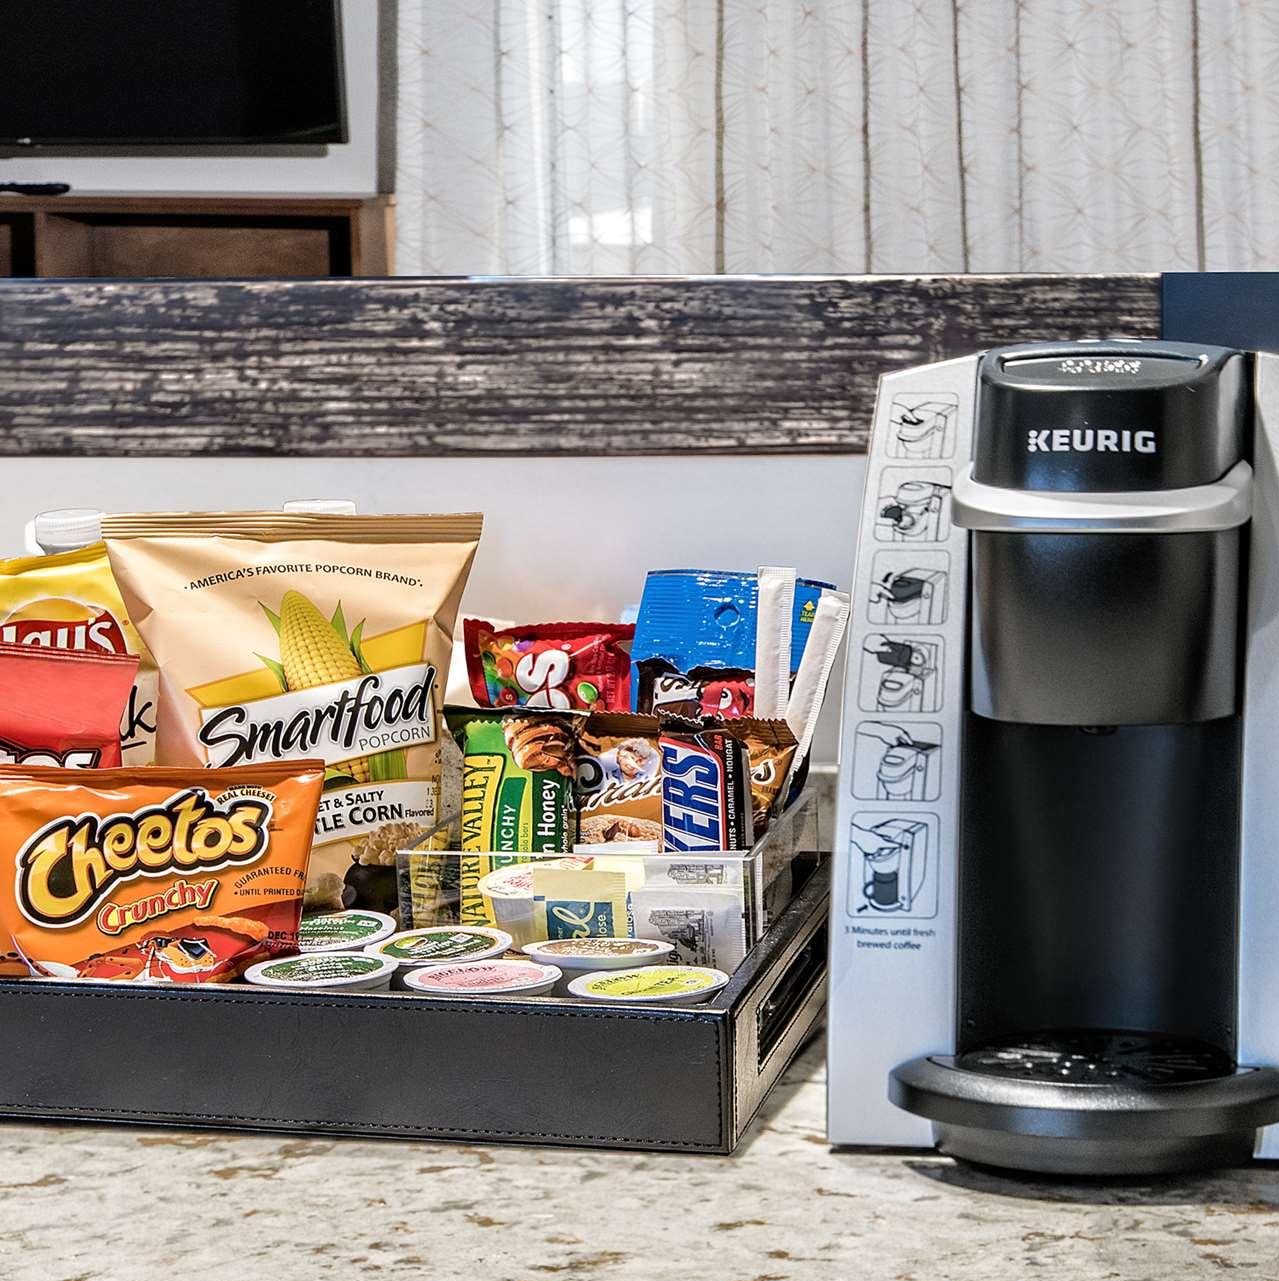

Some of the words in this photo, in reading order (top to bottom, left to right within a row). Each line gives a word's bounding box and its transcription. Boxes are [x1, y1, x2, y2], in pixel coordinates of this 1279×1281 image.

[1027, 430, 1156, 453] KEURIG
[190, 568, 254, 590] AMERICA'S
[256, 564, 312, 576] FAVORITE
[315, 564, 372, 577] POPCORN
[200, 667, 436, 768] Smartfood
[360, 726, 431, 751] POPCORN
[725, 739, 734, 772] NOUGAT
[216, 790, 239, 805] REAL
[240, 789, 275, 802] CHEESE!
[345, 790, 384, 805] SALTY
[463, 765, 497, 844] VALLEY
[537, 779, 560, 836] Honey
[728, 780, 736, 820] CARAMEL
[349, 804, 403, 825] CORN
[405, 808, 435, 818] Flavored
[26, 793, 264, 918] Cheetos
[234, 866, 292, 889] GUARANTEED
[294, 868, 306, 879] FR
[263, 888, 294, 896] PRINTED
[100, 880, 218, 932] Crunchy
[268, 931, 287, 940] DEC
[852, 926, 888, 935] Minutes
[890, 927, 911, 936] until
[856, 940, 891, 949] brewed
[894, 941, 921, 950] coffee
